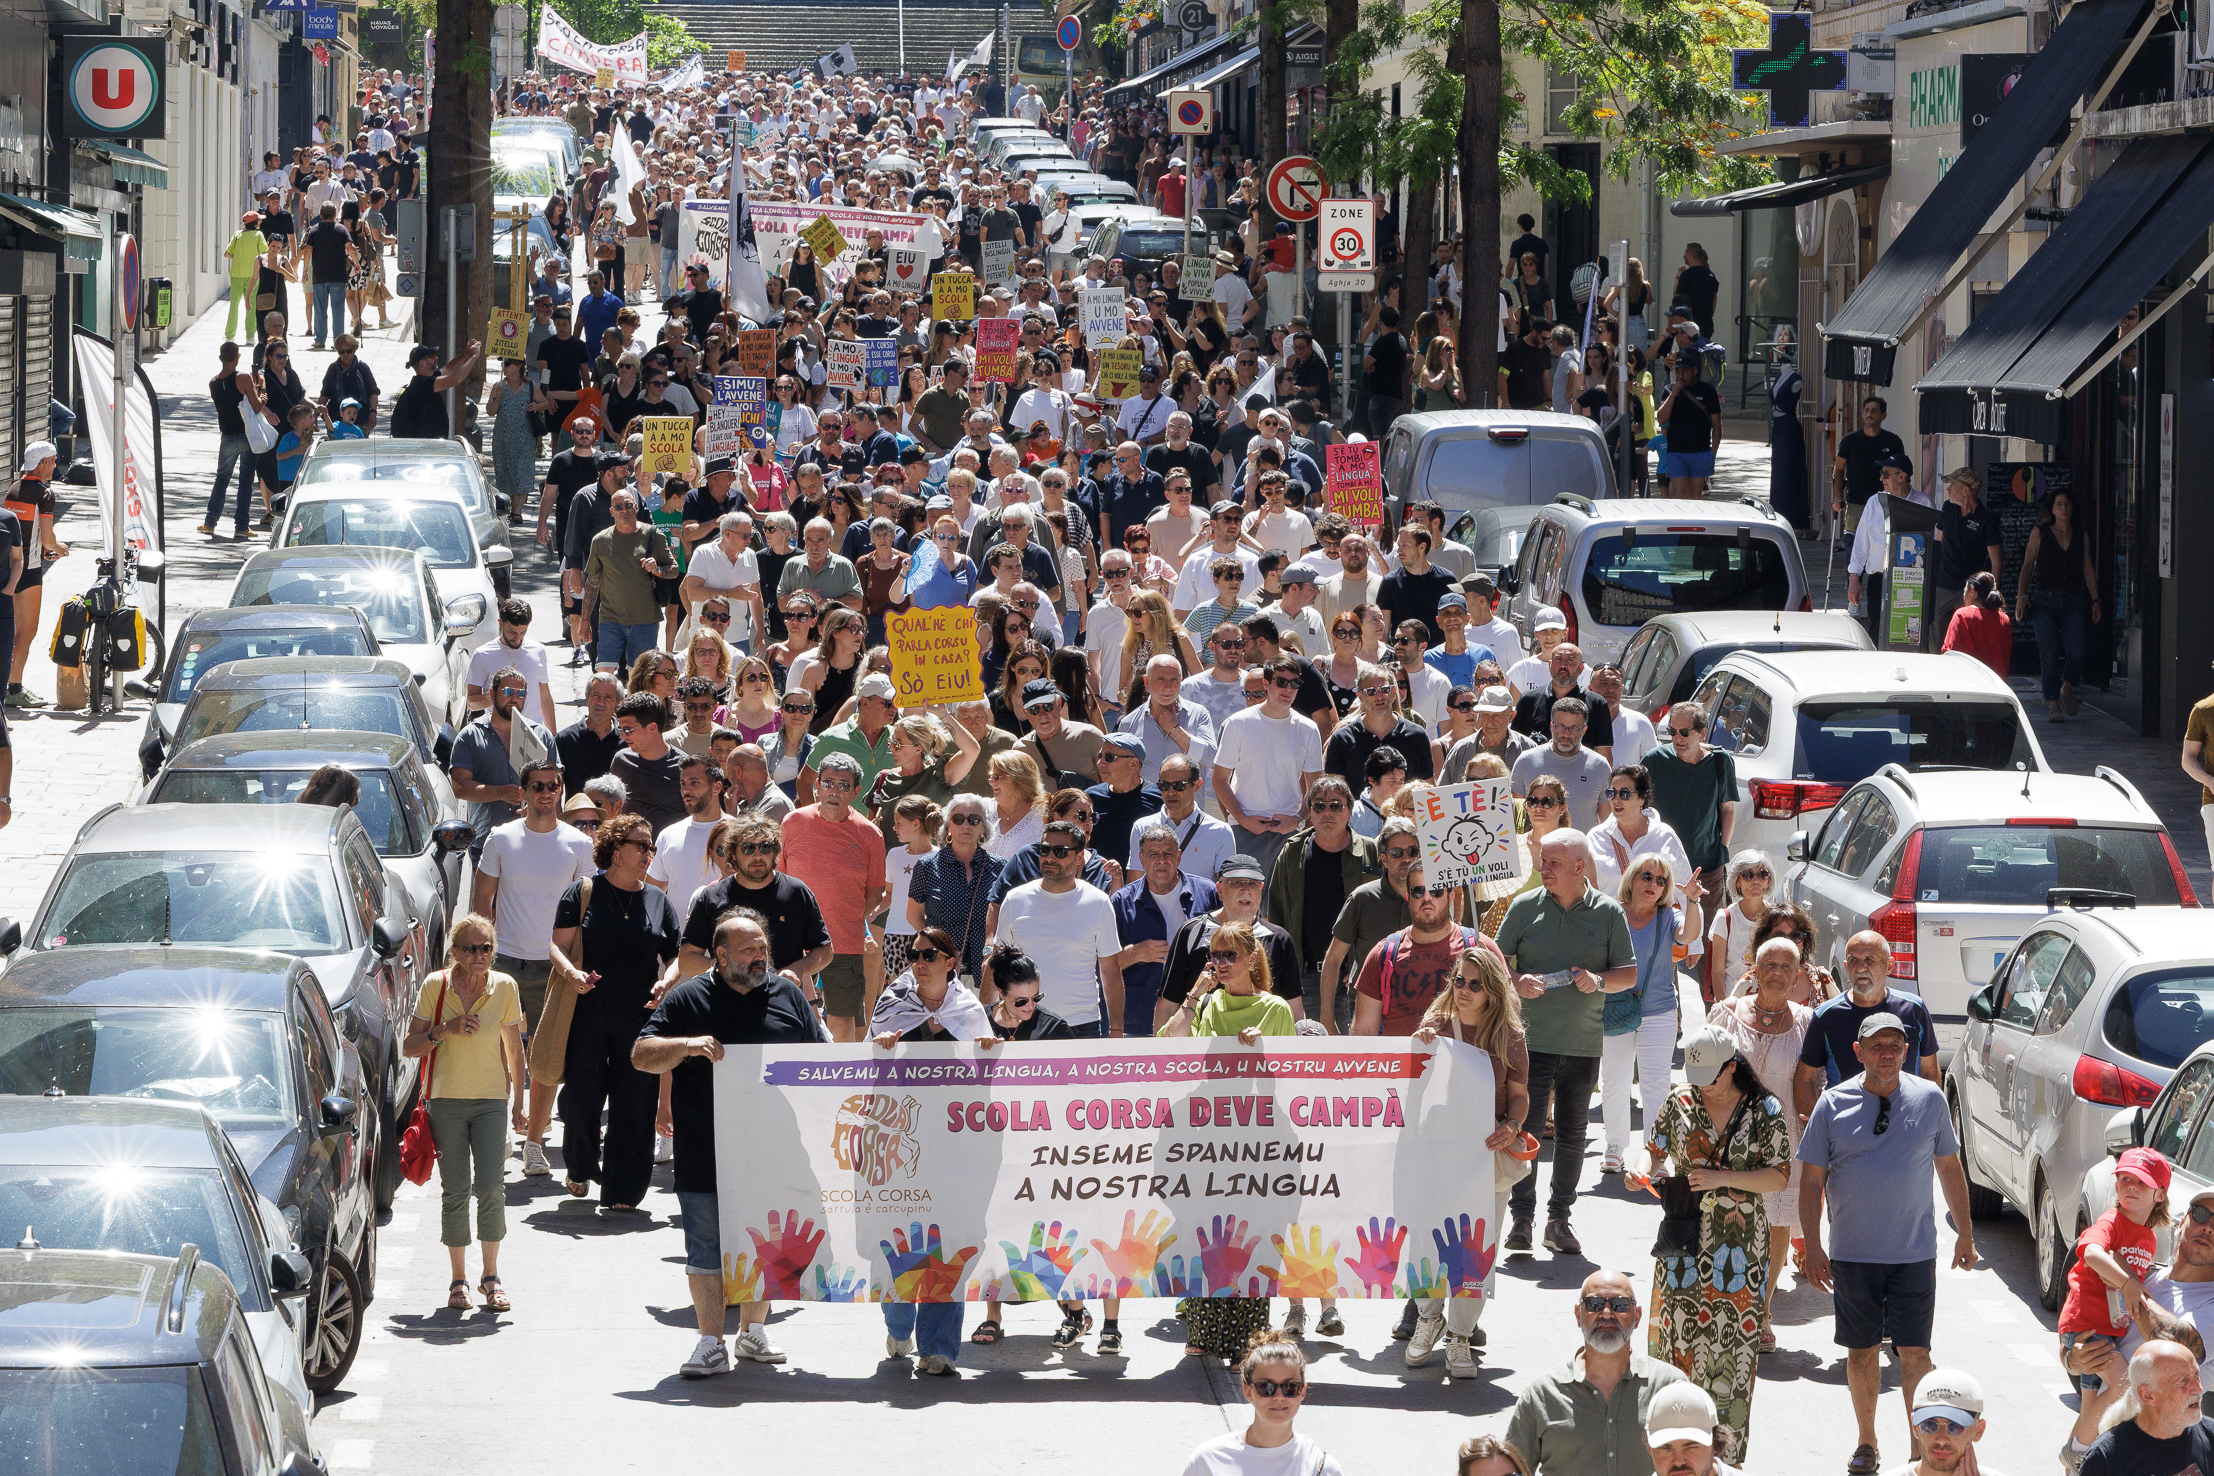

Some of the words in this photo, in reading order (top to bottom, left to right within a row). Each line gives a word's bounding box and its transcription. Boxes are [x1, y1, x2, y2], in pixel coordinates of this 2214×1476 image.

[309, 15, 335, 24] body
[1187, 9, 1202, 23] 21
[545, 12, 593, 51] SCOLA
[92, 69, 135, 110] U
[763, 208, 792, 216] LINGUA,
[1330, 209, 1363, 218] ZONE
[882, 229, 915, 243] AMPÀ
[986, 242, 1007, 250] ZITELLI
[1337, 237, 1357, 251] 30
[896, 252, 916, 264] EIU
[986, 264, 1006, 272] ZITELLI
[1187, 259, 1212, 269] LINGUA
[1194, 269, 1210, 279] VIVA
[892, 280, 901, 288] MO
[902, 282, 920, 290] LINGUA
[1188, 280, 1208, 288] POPULU
[1328, 279, 1351, 287] Aghja
[1190, 288, 1204, 296] VIVU
[938, 294, 969, 304] SCOLA
[1087, 296, 1092, 304] A
[1092, 295, 1102, 304] MO
[497, 310, 526, 322] ATTENTI
[1094, 306, 1100, 318] U
[1104, 306, 1118, 316] MO
[1089, 318, 1124, 332] AVVENE
[495, 338, 519, 349] ZITELLU
[834, 342, 840, 352] A
[841, 344, 856, 354] MO
[876, 341, 894, 350] CORSU
[491, 346, 498, 354] IN
[500, 348, 519, 358] ZERGA
[871, 350, 881, 359] ESSE
[882, 350, 896, 358] CORSU
[1102, 352, 1106, 360] A
[1108, 352, 1116, 360] MO
[978, 354, 991, 364] MI
[993, 354, 1014, 364] VOLI
[830, 363, 836, 371] U
[837, 364, 849, 372] MO
[1111, 362, 1131, 370] TESORU
[828, 370, 854, 384] AVVENE
[724, 380, 756, 390] SIMU
[713, 408, 726, 419] HEY
[660, 433, 666, 442] A
[670, 433, 685, 442] MO
[710, 432, 723, 441] LEAVE
[724, 432, 733, 440] OUR
[649, 443, 685, 454] SCOLA
[708, 440, 737, 454] LANGUAGE
[1338, 464, 1346, 472] A
[1350, 462, 1366, 471] MO
[1333, 489, 1349, 505] MI
[1351, 488, 1378, 502] VOLI
[896, 638, 932, 653] PARLA
[934, 637, 968, 650] CORSU
[934, 650, 970, 665] CASA?
[1426, 790, 1446, 822] È
[1438, 867, 1453, 880] S'È
[1456, 864, 1469, 878] TÙ
[1488, 861, 1509, 872] VOLI
[1470, 876, 1484, 885] MO
[1400, 953, 1420, 969] BACK
[798, 1066, 879, 1081] SALVEMU
[886, 1066, 899, 1080] A
[904, 1066, 978, 1080] NOSTRA
[983, 1064, 1060, 1080] LINGUA,
[1067, 1063, 1079, 1077] A
[1086, 1060, 1157, 1076] NOSTRA
[1164, 1059, 1230, 1075] SCOLA,
[1236, 1060, 1249, 1073] U
[1255, 1060, 1326, 1074] NOSTRU
[1332, 1060, 1402, 1074] AVVENE
[947, 1100, 1052, 1132] SCOLA
[1066, 1097, 1174, 1130] CORSA
[1189, 1095, 1274, 1128] DEVE
[1289, 1088, 1406, 1128] CAMPÀ
[1030, 1143, 1153, 1167] INSEME
[1165, 1141, 1325, 1164] SPANNEMU
[1014, 1177, 1036, 1202] A
[1050, 1172, 1192, 1201] NOSTRA
[1204, 1171, 1341, 1199] LINGUA
[820, 1190, 874, 1202] SCOLA
[878, 1189, 932, 1202] CORSA
[820, 1203, 861, 1214] sarrula
[865, 1202, 872, 1214] è
[876, 1202, 932, 1218] carcupinu
